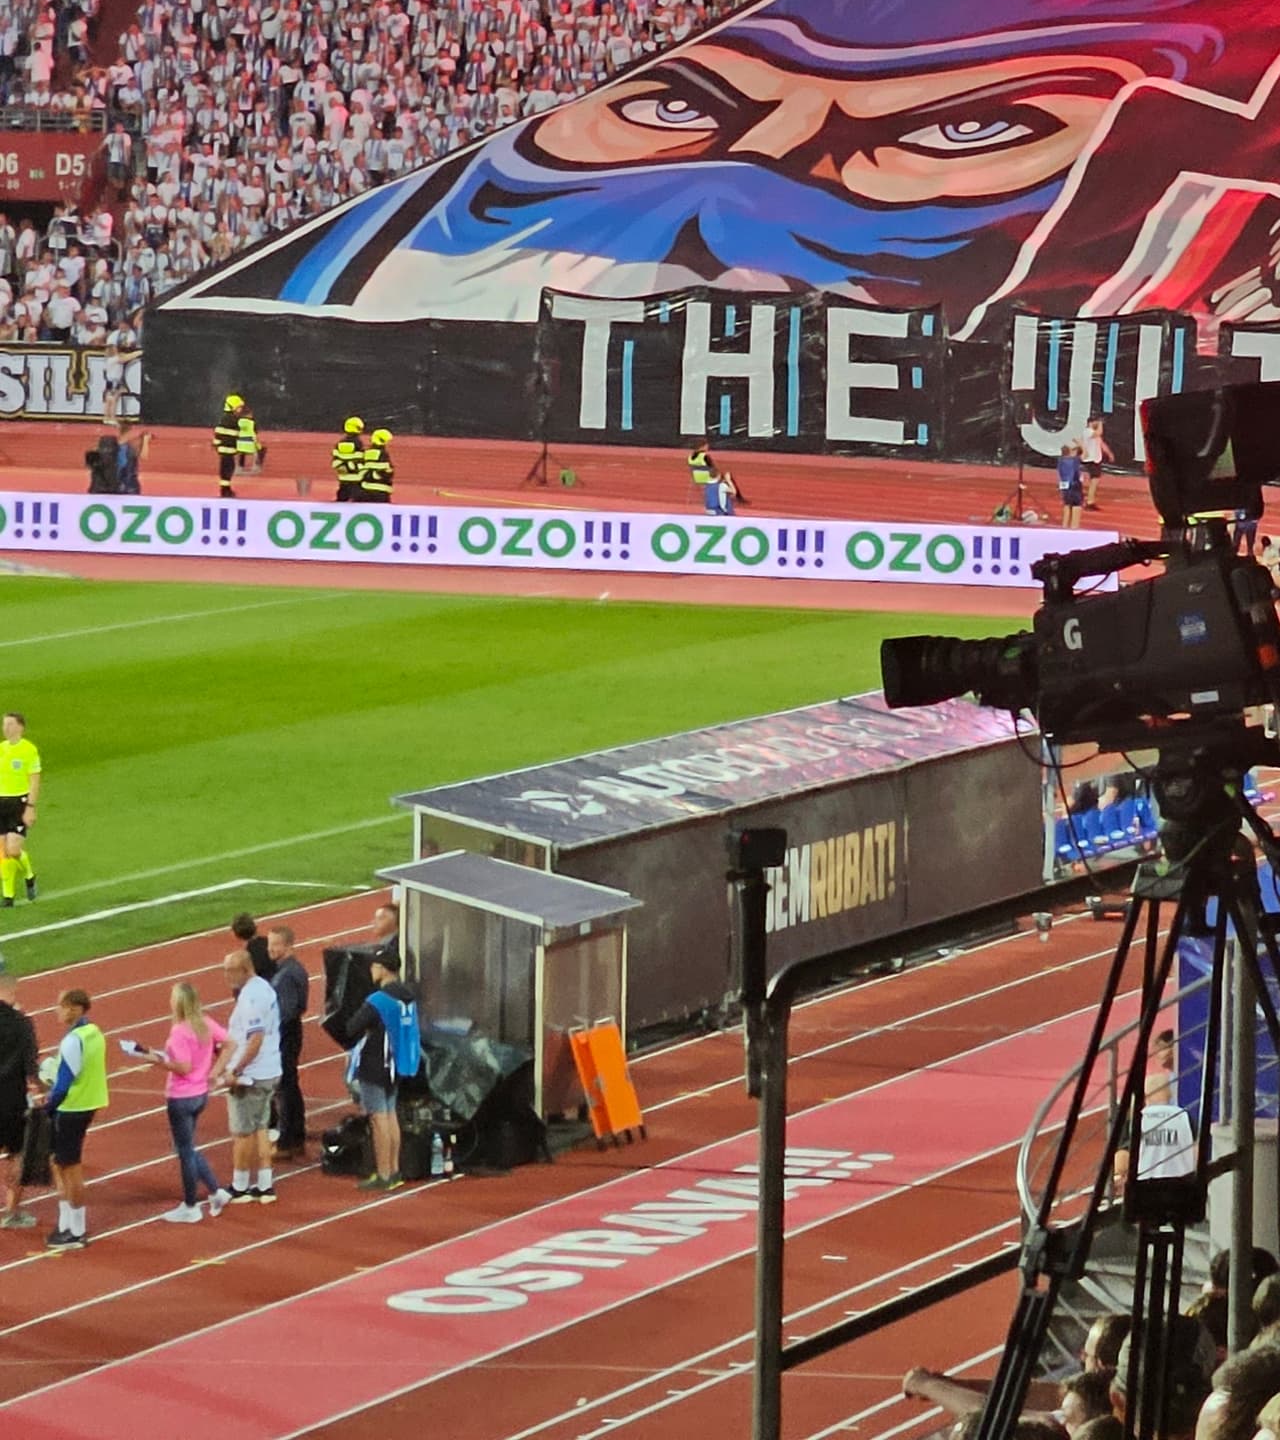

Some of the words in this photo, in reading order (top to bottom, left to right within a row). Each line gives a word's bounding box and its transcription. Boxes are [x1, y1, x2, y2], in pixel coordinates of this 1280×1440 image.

[55, 152, 86, 176] D5
[552, 296, 909, 445] THE
[79, 503, 247, 547] OZO!!!
[267, 510, 437, 554] OZO!!!
[458, 516, 631, 560] OZO!!!
[650, 523, 825, 568] OZO!!!
[845, 530, 1021, 576] OZO!!!
[1063, 618, 1083, 650] G
